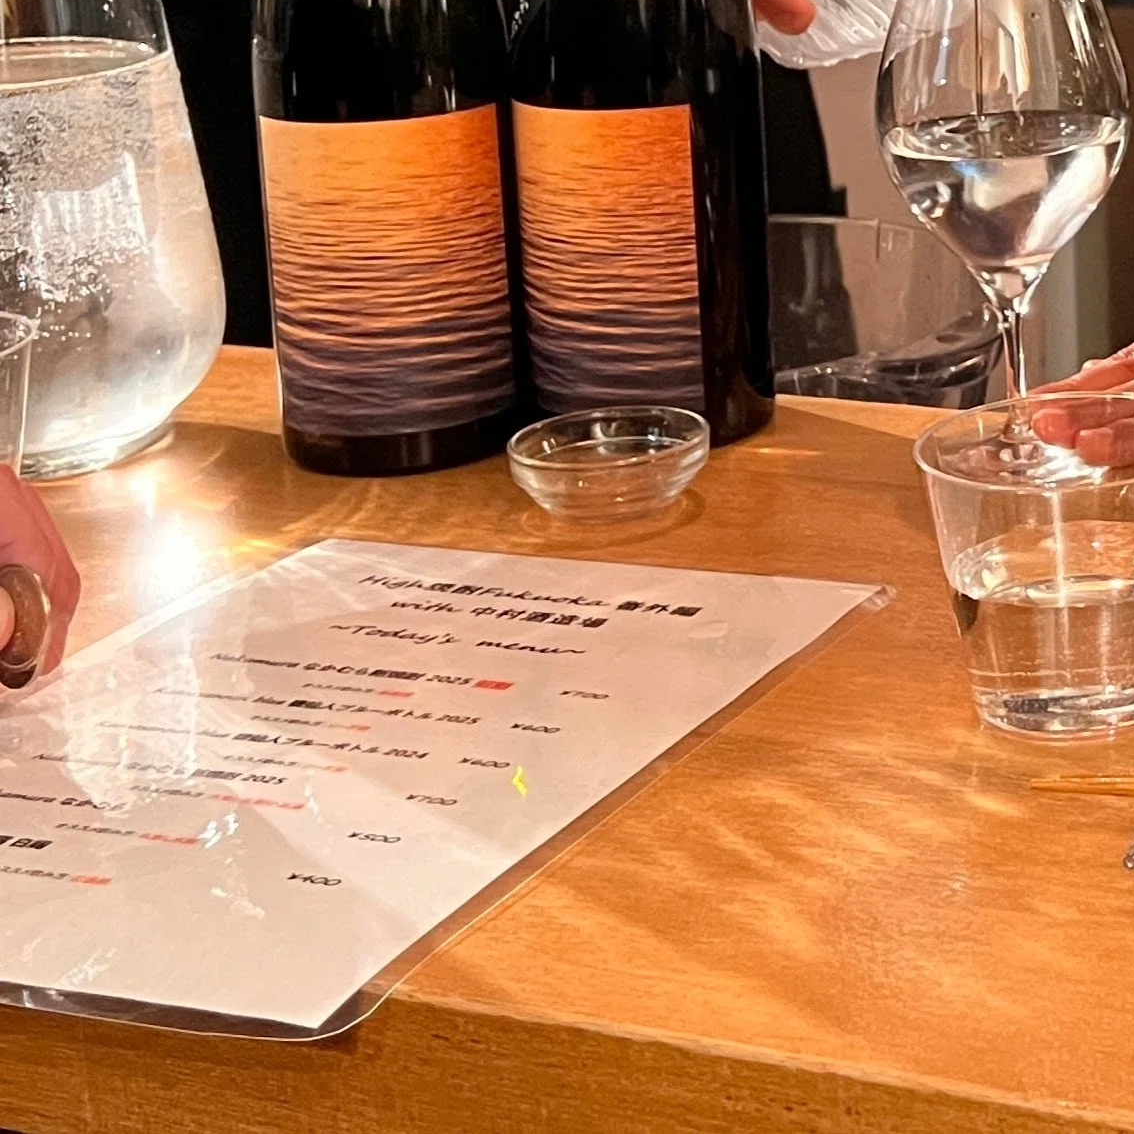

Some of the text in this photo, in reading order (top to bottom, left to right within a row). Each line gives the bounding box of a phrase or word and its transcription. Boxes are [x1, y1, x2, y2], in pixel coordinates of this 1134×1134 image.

[390, 600, 464, 614] with
[426, 674, 475, 686] 2025
[435, 714, 481, 726] 2025
[510, 722, 561, 734] ¥600
[382, 748, 430, 759] 2024
[458, 757, 511, 769] ¥600
[241, 774, 290, 785] 2025
[405, 793, 458, 806] ¥700
[347, 831, 402, 844] ¥500
[286, 872, 343, 886] ¥400
